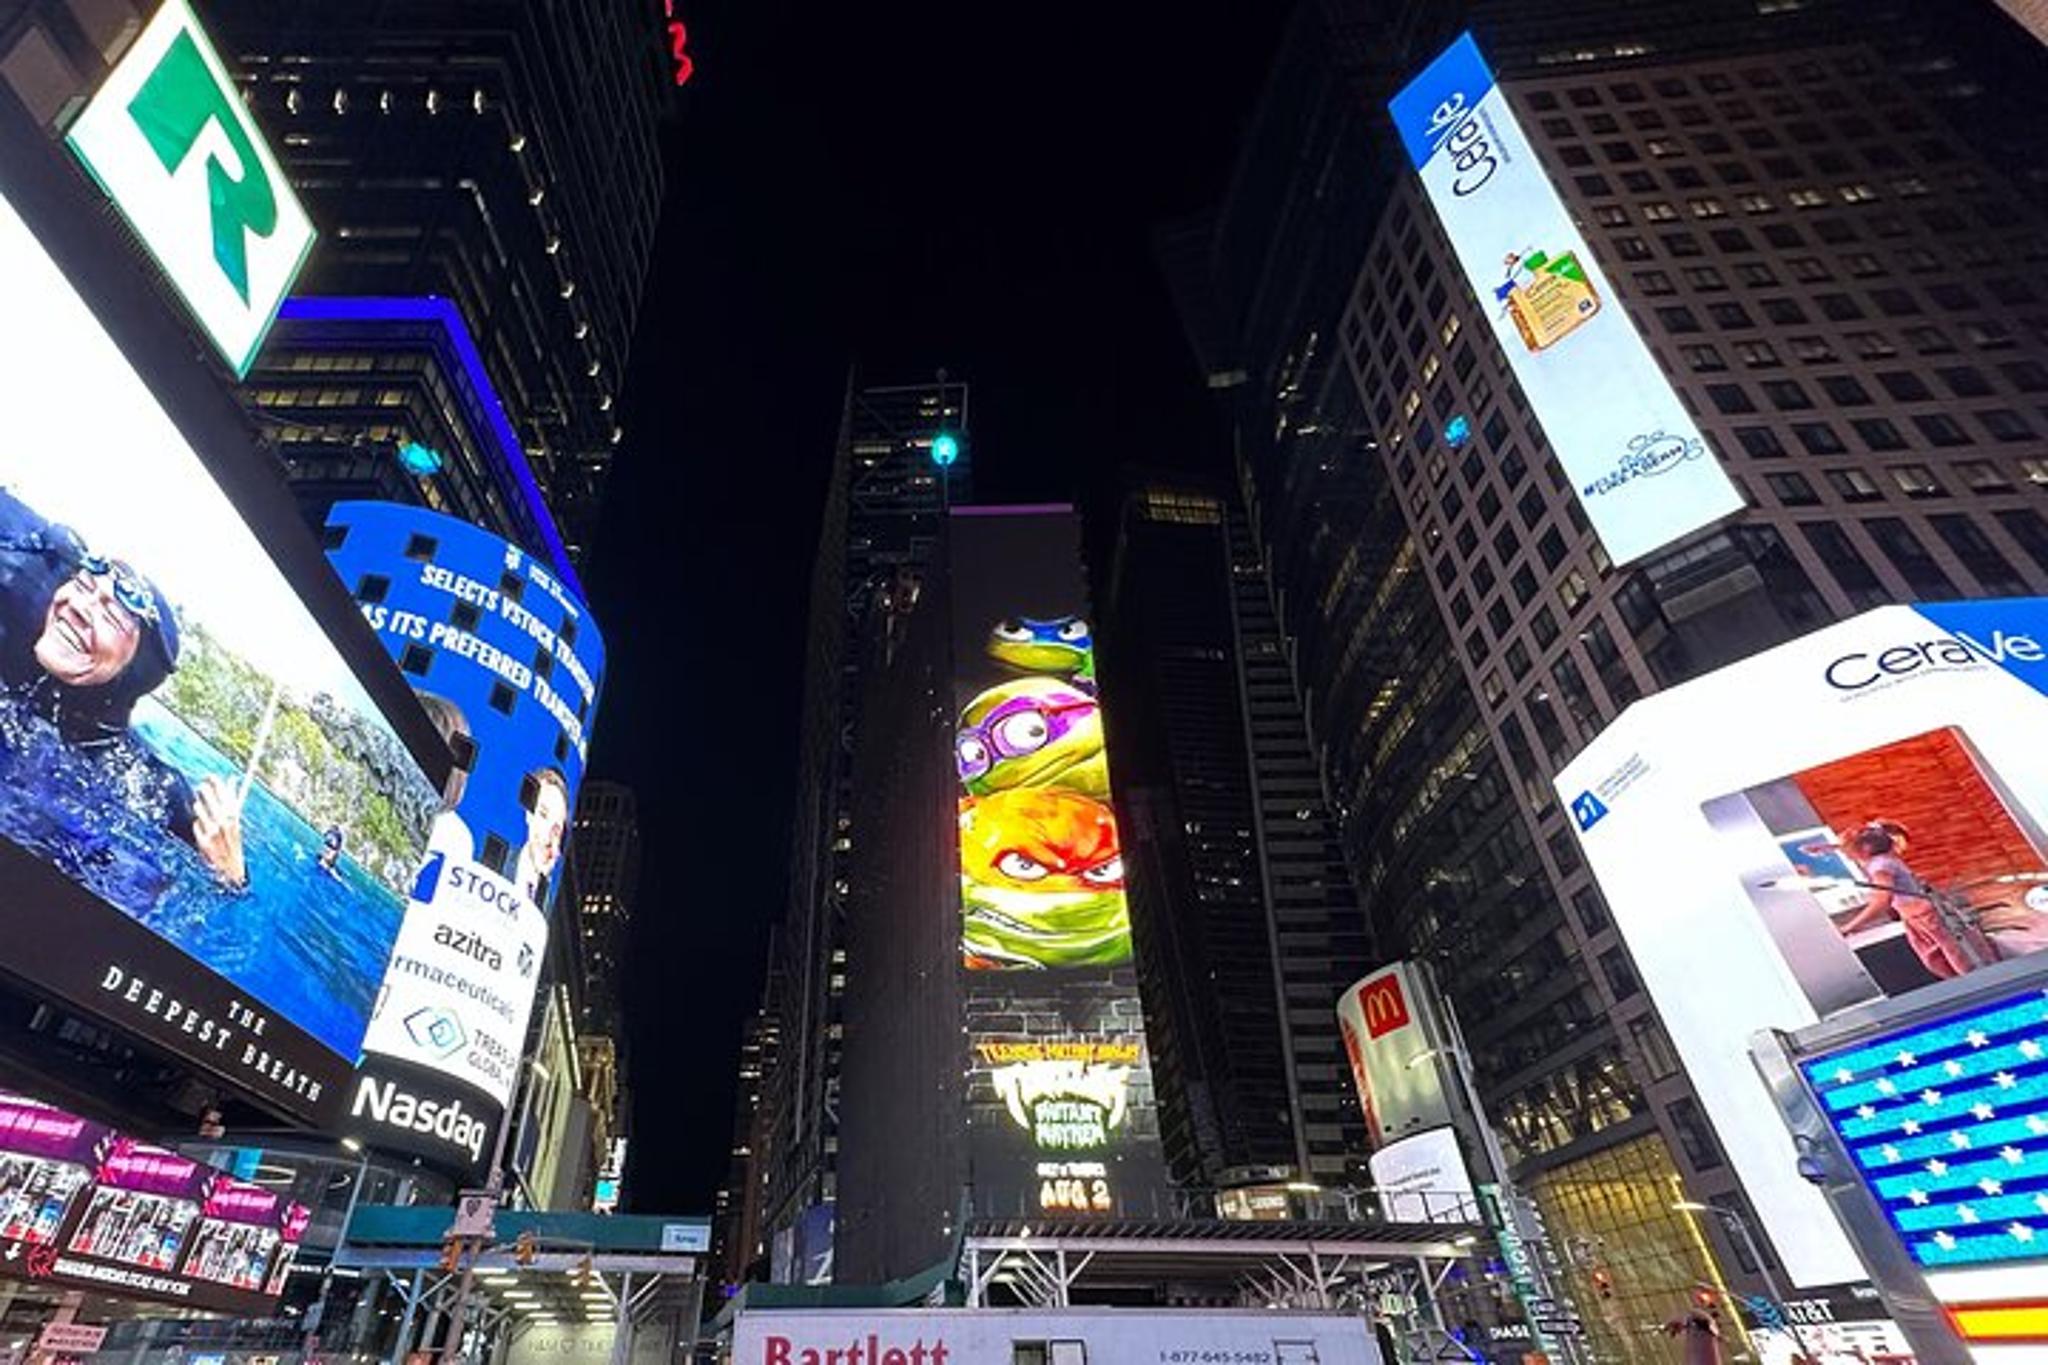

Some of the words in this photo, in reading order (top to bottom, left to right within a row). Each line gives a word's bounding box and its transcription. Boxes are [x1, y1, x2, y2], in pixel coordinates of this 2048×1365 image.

[1424, 92, 1497, 197] CeraVe
[420, 564, 499, 611] SELECTS
[501, 596, 556, 652] VSTOCK
[389, 610, 428, 639] ITS
[428, 622, 532, 690] PREFERRED
[1825, 630, 2047, 690] CeraVe
[448, 866, 522, 922] STOCK
[433, 922, 503, 972] azitra
[101, 965, 232, 1050] DEEPEST
[242, 1043, 323, 1102] BREATH
[227, 1000, 268, 1036] THE
[351, 1076, 488, 1162] Nasdaq
[1092, 1179, 1111, 1210] 2
[765, 1334, 949, 1365] Bartlett
